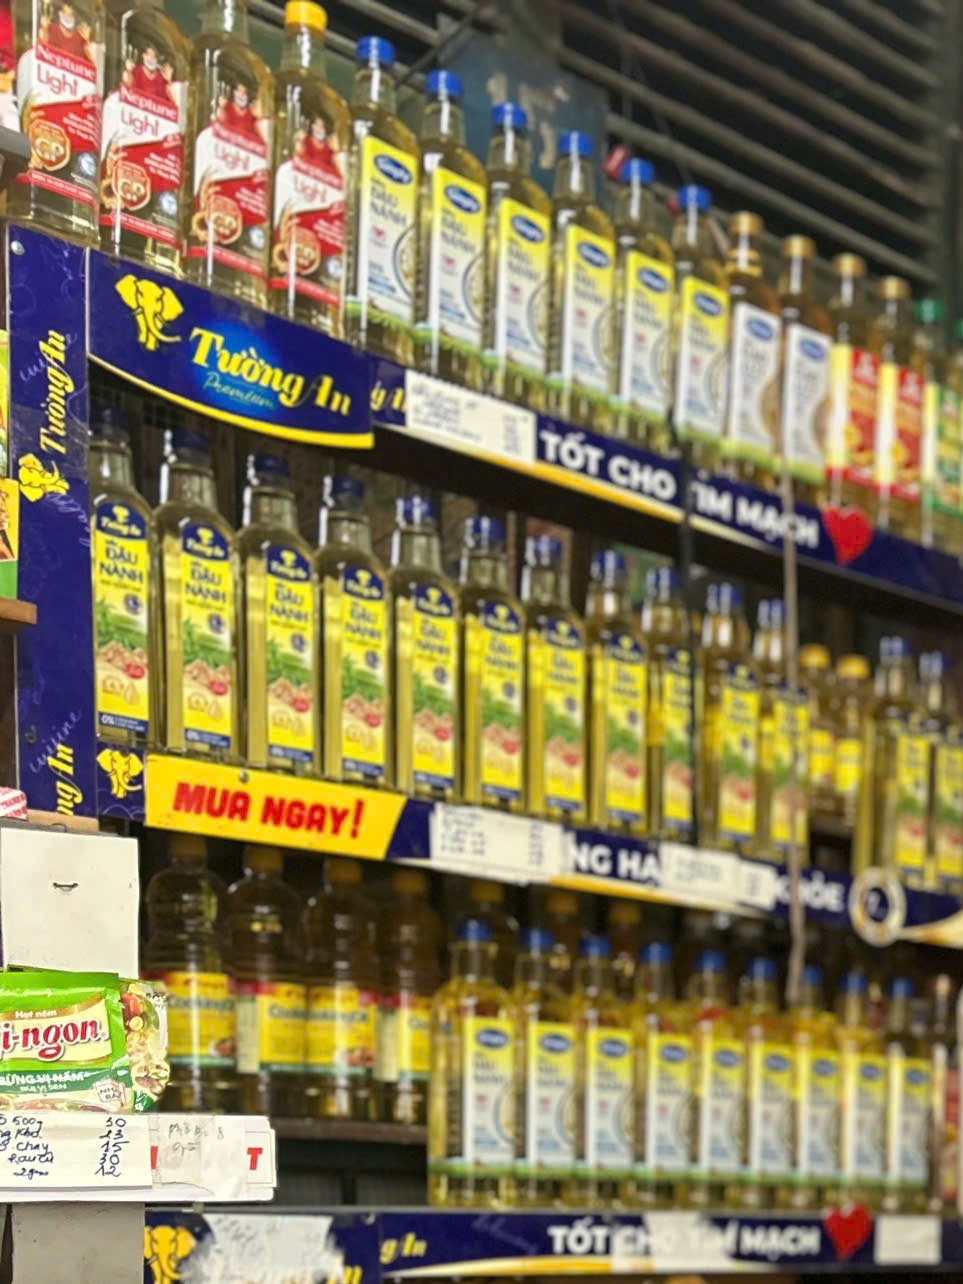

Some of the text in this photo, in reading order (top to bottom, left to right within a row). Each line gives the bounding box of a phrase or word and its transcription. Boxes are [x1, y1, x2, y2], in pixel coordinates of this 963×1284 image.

[36, 43, 96, 83] Neptune
[36, 63, 79, 96] Light
[119, 85, 178, 121] Neptune
[120, 106, 159, 137] Light
[540, 430, 605, 476] TỐT
[608, 455, 677, 501] CHO
[173, 782, 365, 839] MUA NGAY!
[570, 842, 612, 877] NG
[0, 1019, 99, 1060] i-ngon
[547, 1216, 610, 1255] TỐT
[739, 1225, 822, 1261] MẠCH
